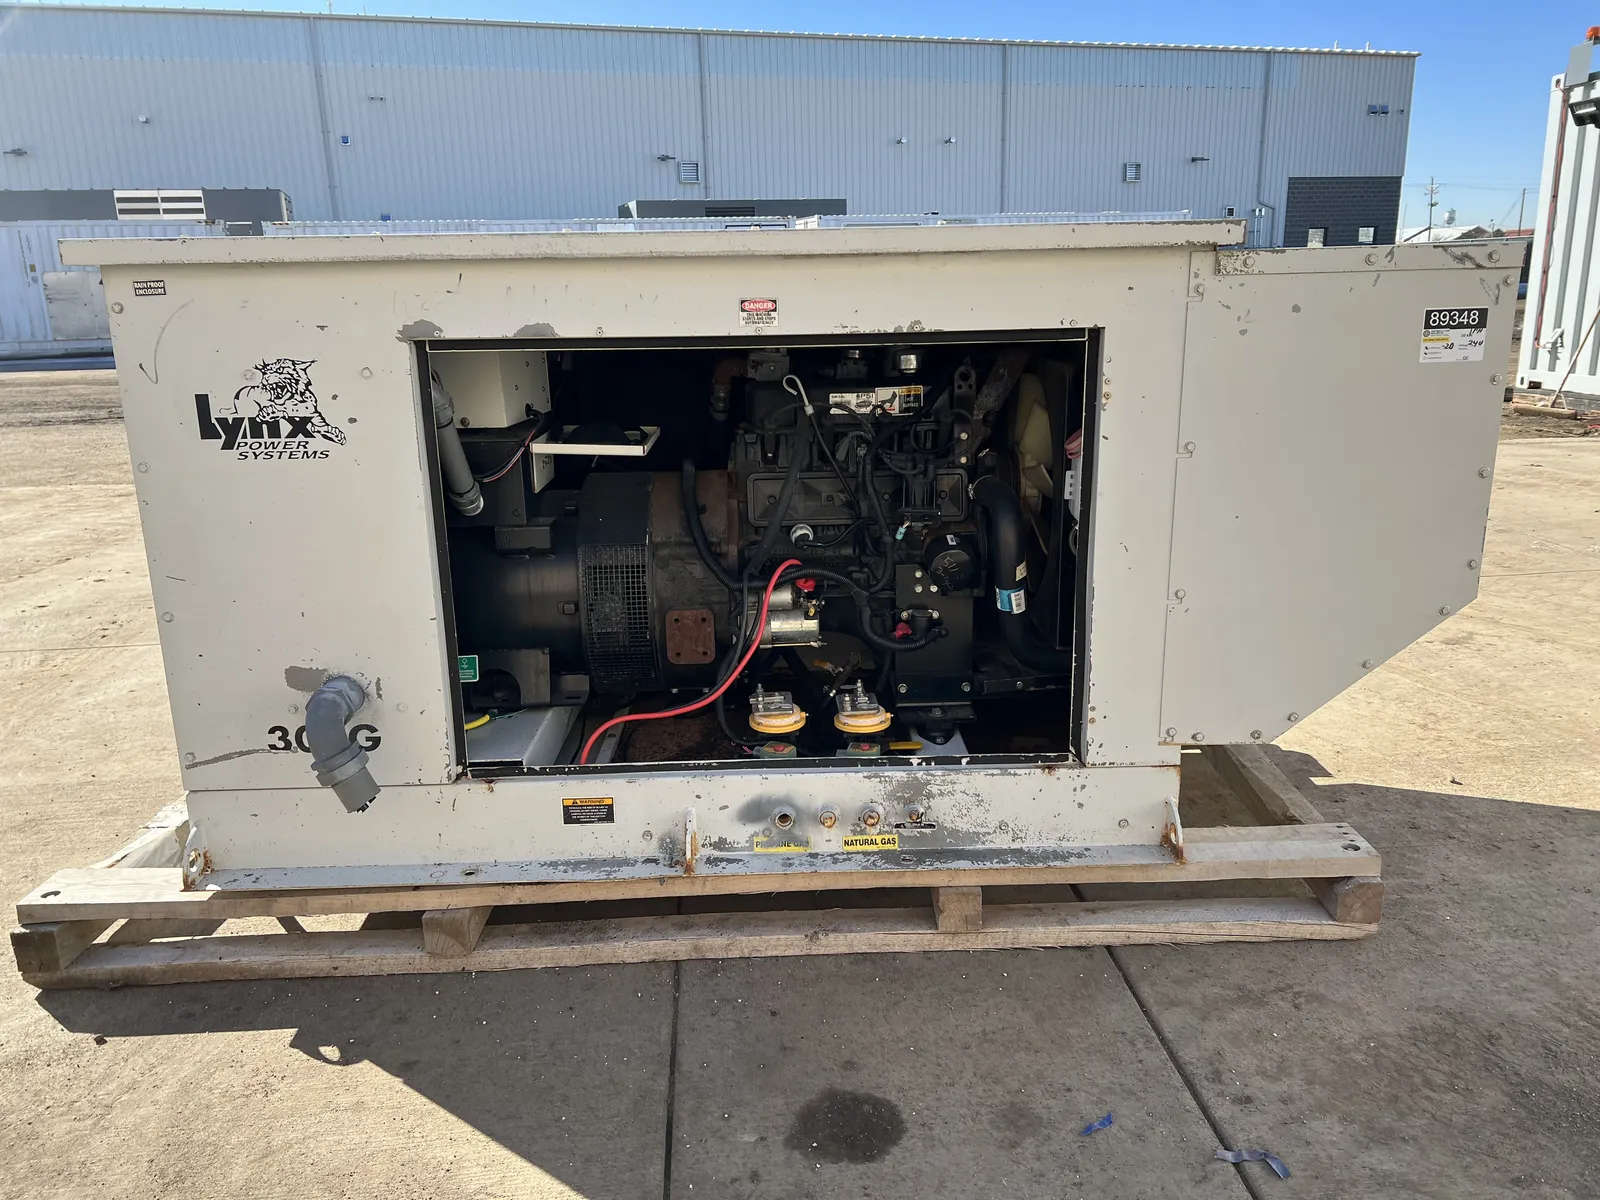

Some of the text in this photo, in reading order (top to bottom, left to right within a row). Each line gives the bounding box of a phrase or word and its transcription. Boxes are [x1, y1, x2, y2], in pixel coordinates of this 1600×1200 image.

[1429, 310, 1479, 326] 89348
[194, 393, 317, 451] Lynx
[235, 440, 310, 451] POWER
[237, 450, 330, 461] SYSTEMS
[843, 837, 897, 847] NATURAL GAS
